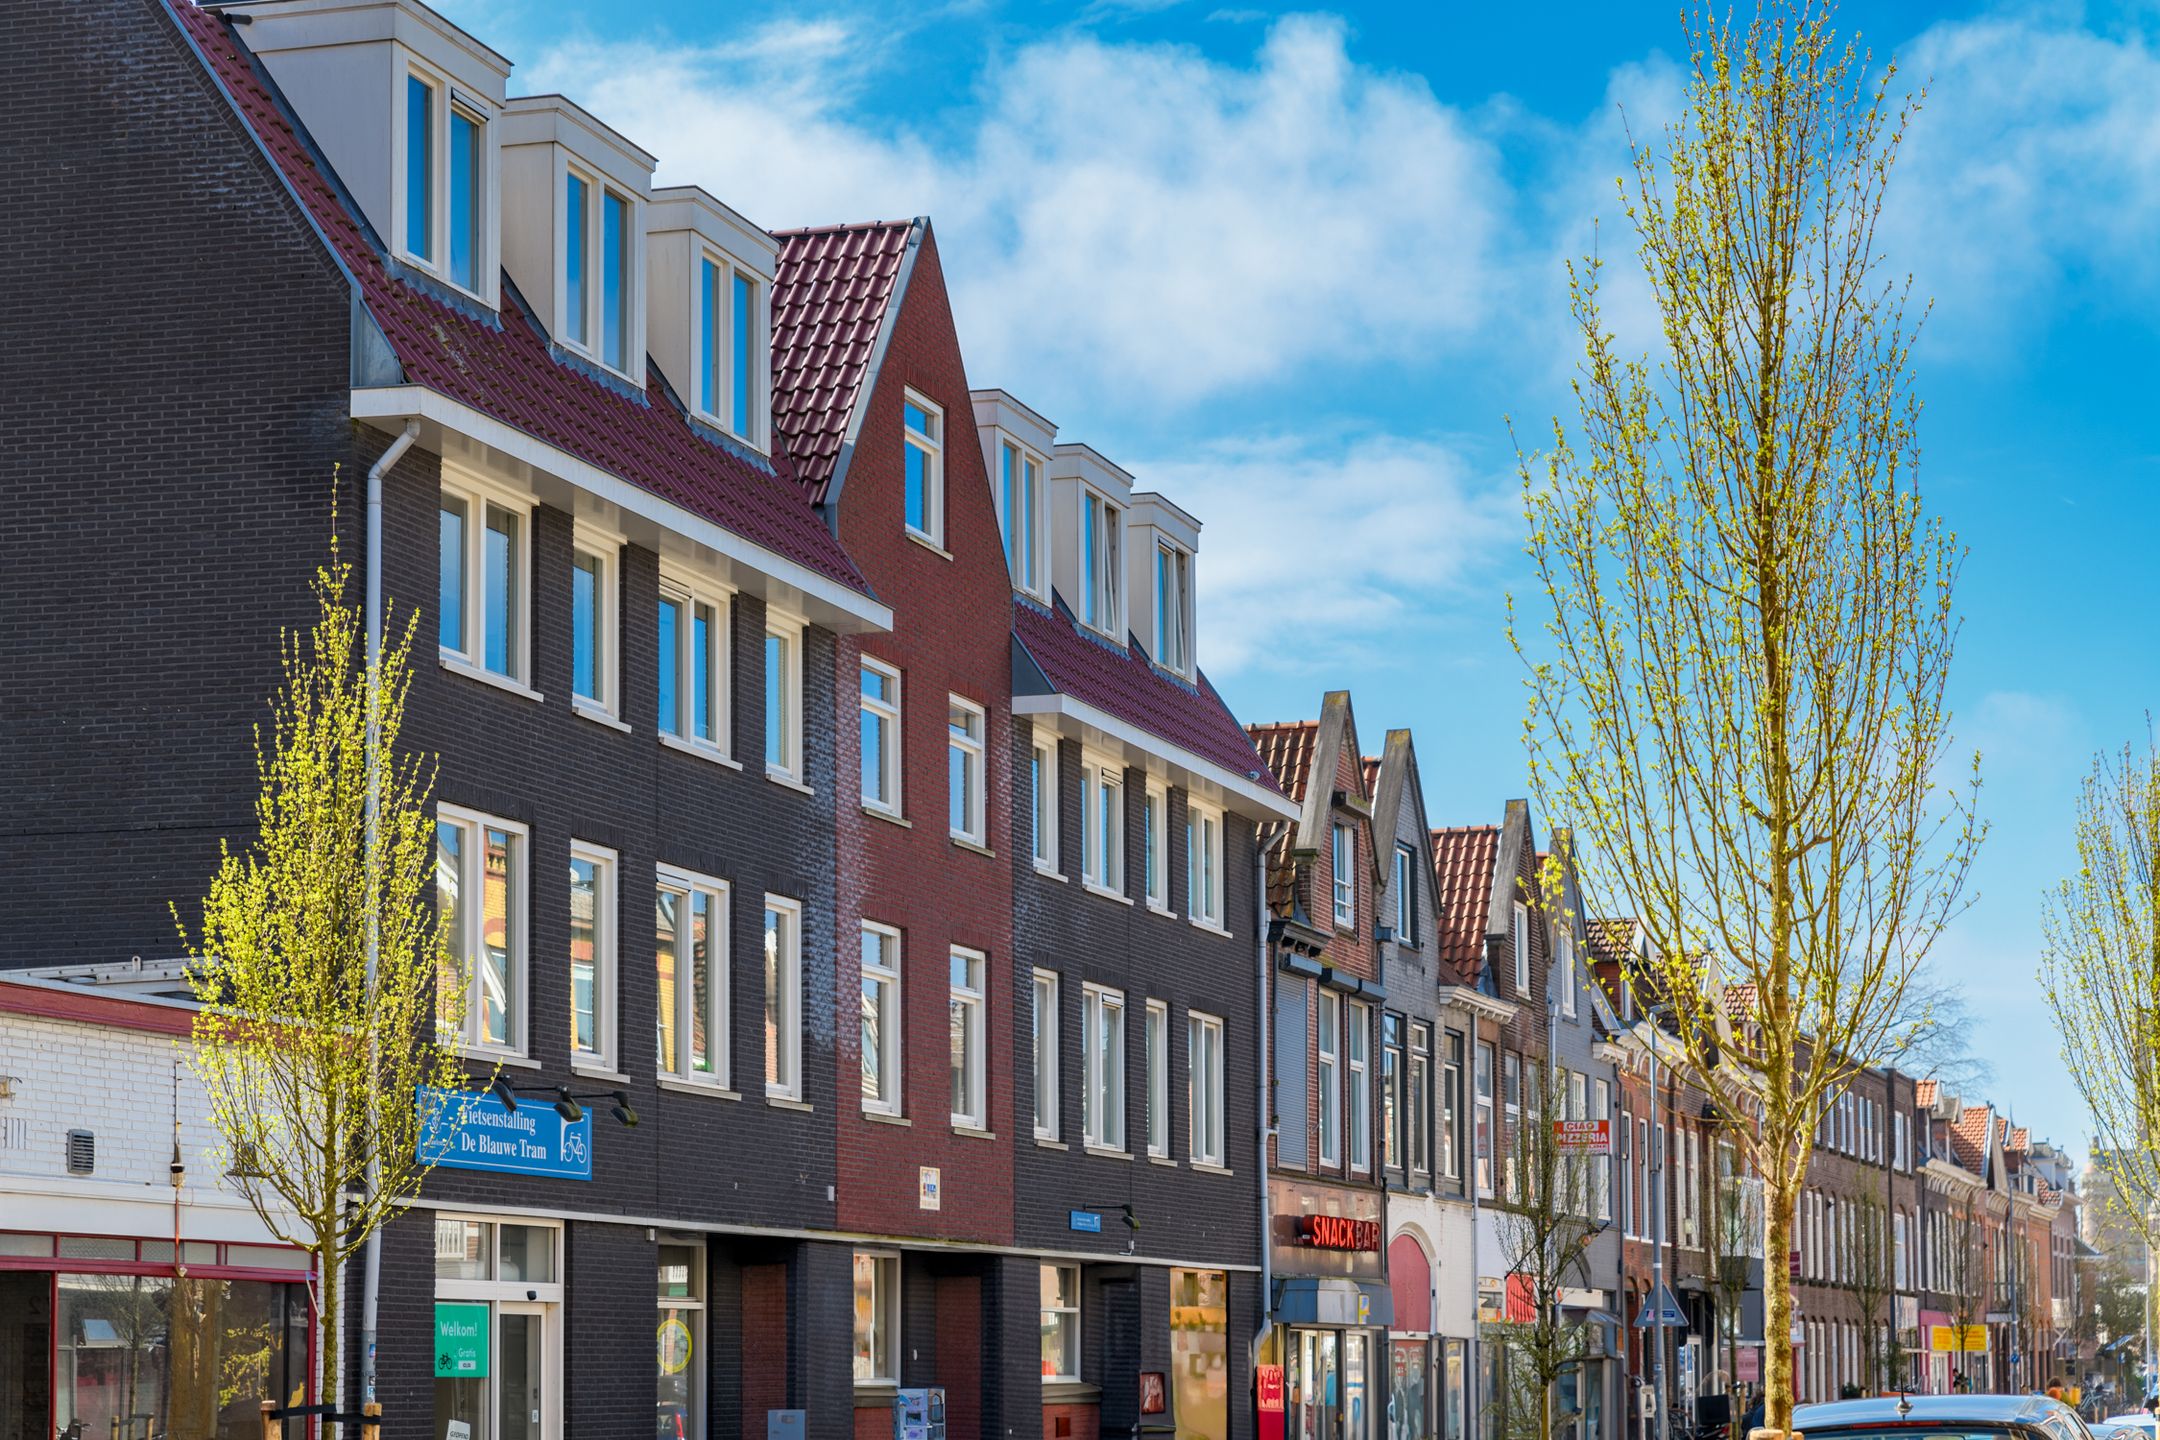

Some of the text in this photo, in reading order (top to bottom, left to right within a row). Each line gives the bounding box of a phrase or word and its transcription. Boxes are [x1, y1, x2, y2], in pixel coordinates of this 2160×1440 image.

[1567, 1122, 1594, 1130] CIAO
[461, 1132, 476, 1152] De
[479, 1134, 517, 1156] Blauwe
[519, 1138, 547, 1160] Tram
[1555, 1132, 1608, 1143] PIZZERIA
[1313, 1215, 1380, 1250] SNACKBAR
[440, 1320, 478, 1337] Welkom!
